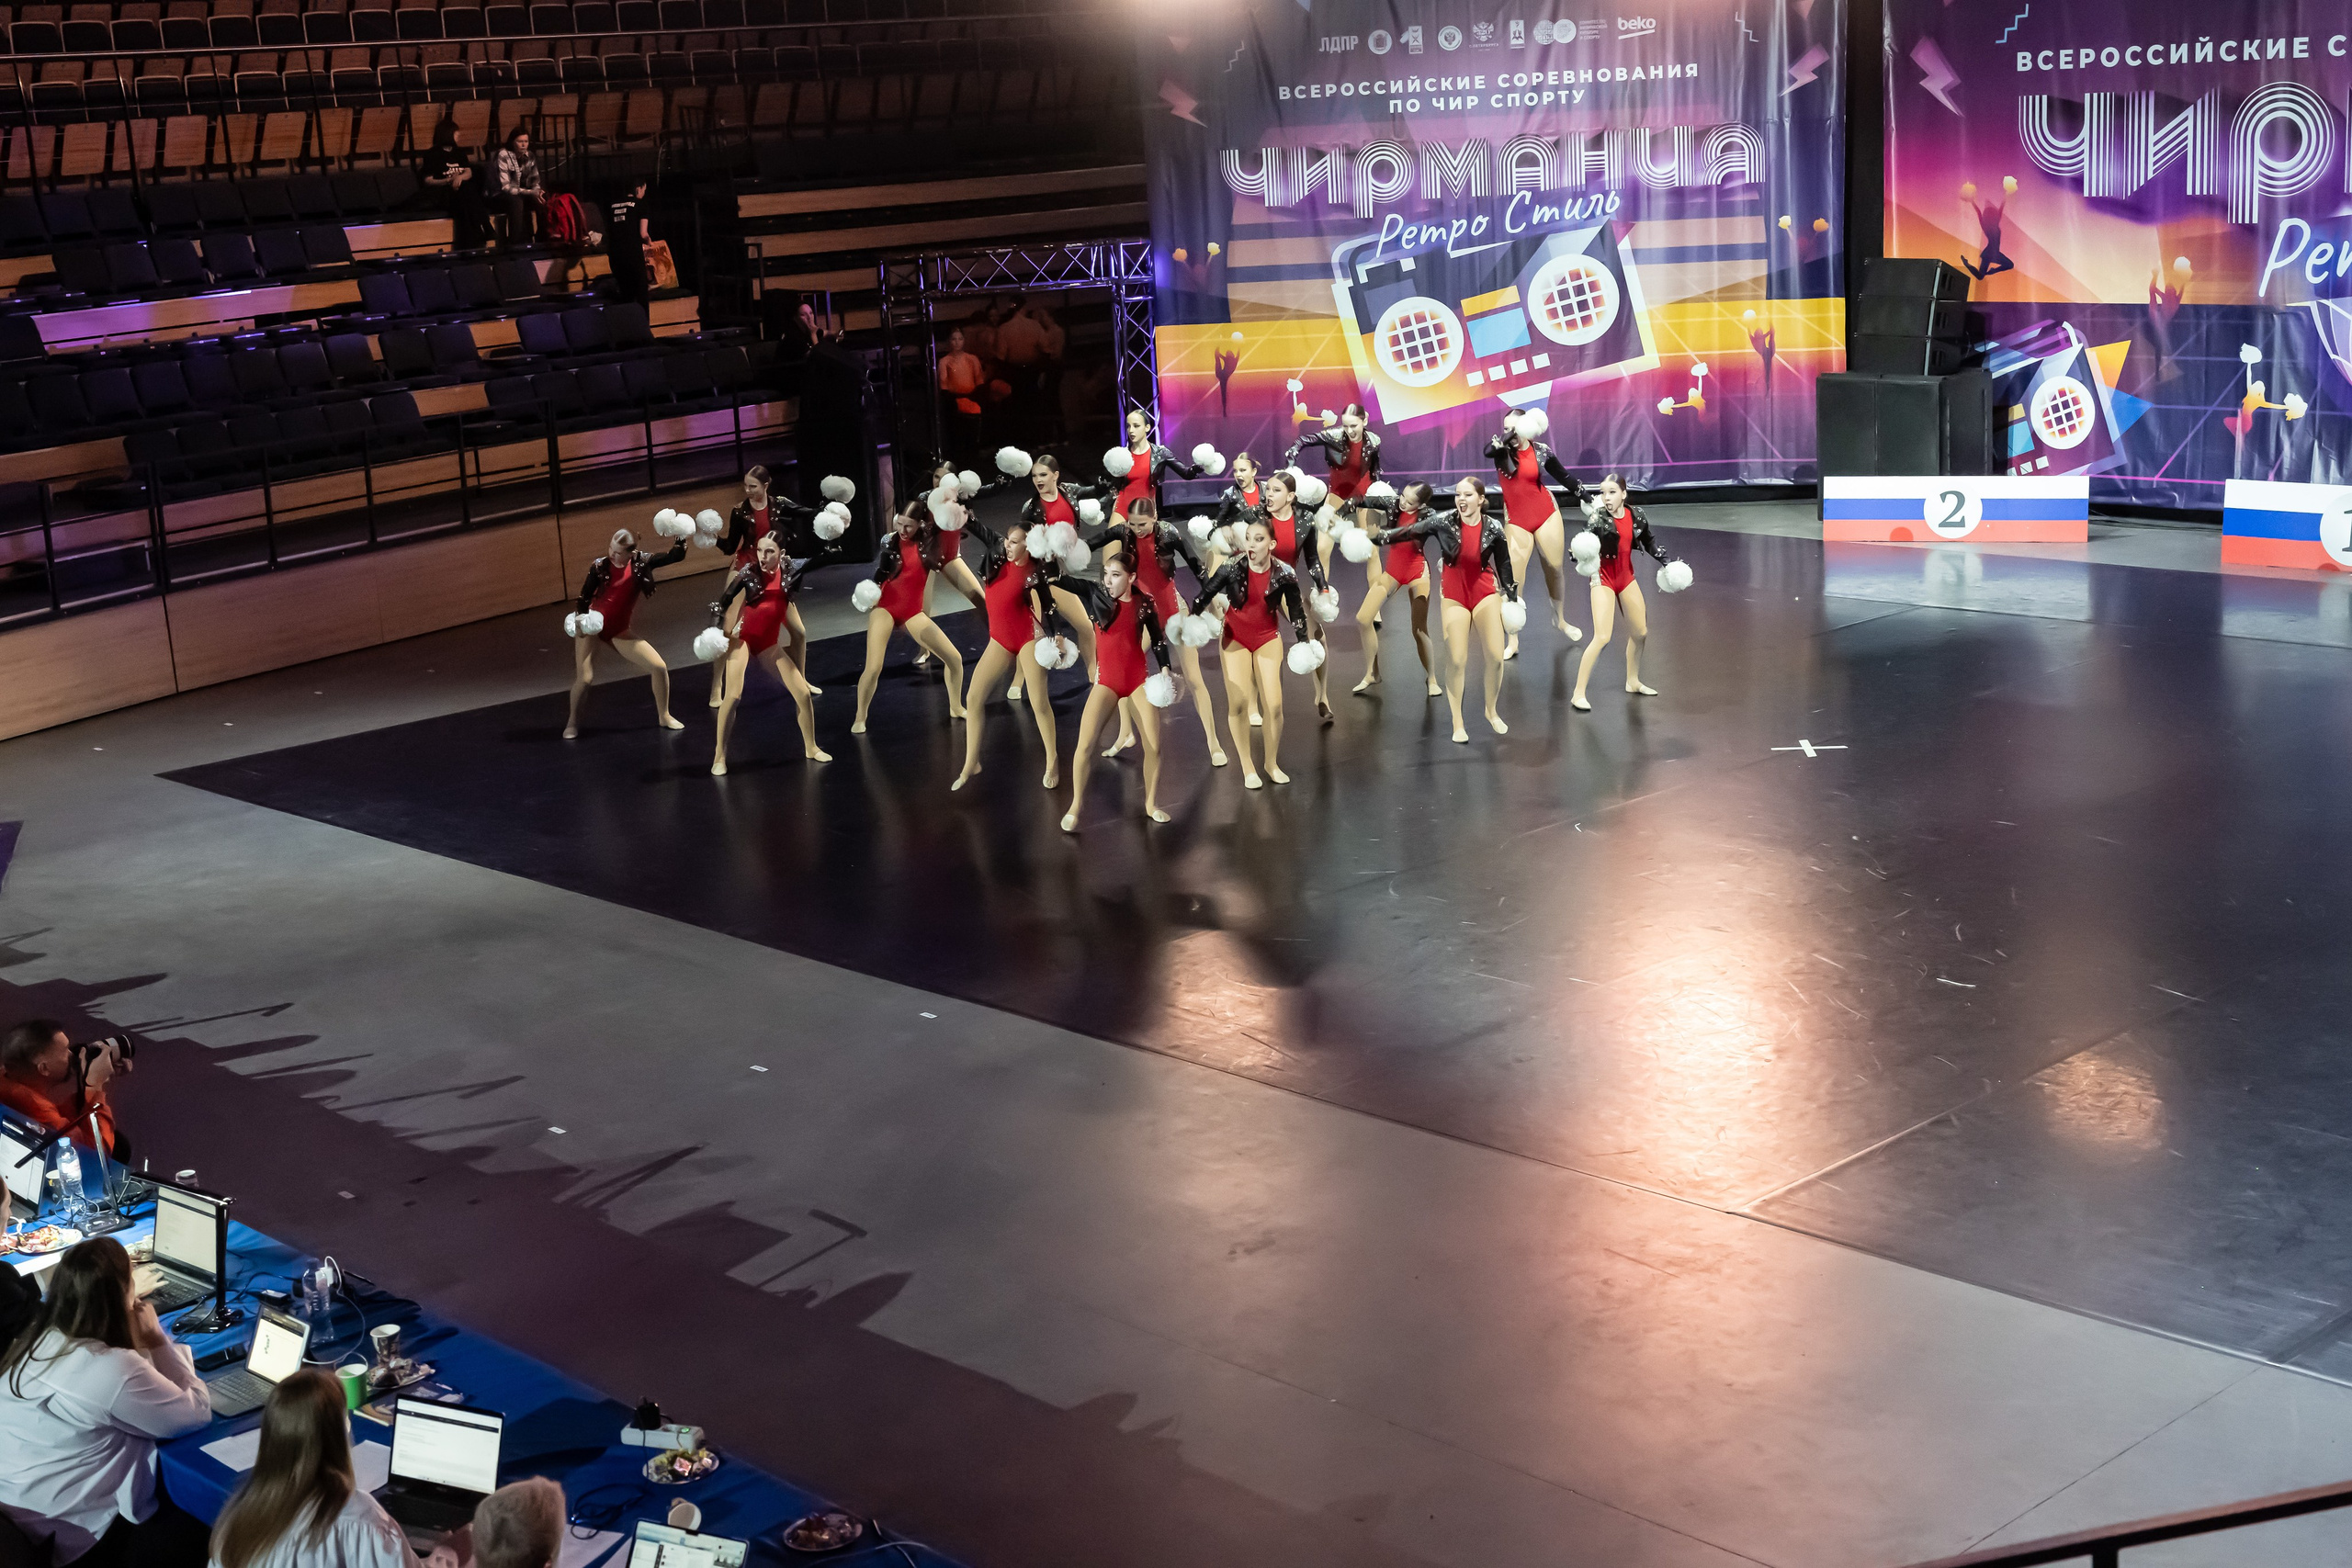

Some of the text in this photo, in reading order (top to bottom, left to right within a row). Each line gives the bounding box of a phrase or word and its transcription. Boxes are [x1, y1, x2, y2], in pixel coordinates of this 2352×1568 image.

[1617, 16, 1657, 31] beko
[1318, 35, 1359, 54] ЛДПР
[2017, 37, 2310, 72] ВСЕРОССИЙСКИЕ
[1279, 62, 1700, 100] ВСЕРОССИЙСКИЕ СОРЕВНОВАНИЯ
[1389, 89, 1586, 114] ПО ЧИР СПОРТУ
[2018, 81, 2352, 224] ЧИР
[1376, 189, 1622, 259] Ретро Стиль
[1938, 490, 1967, 529] 2
